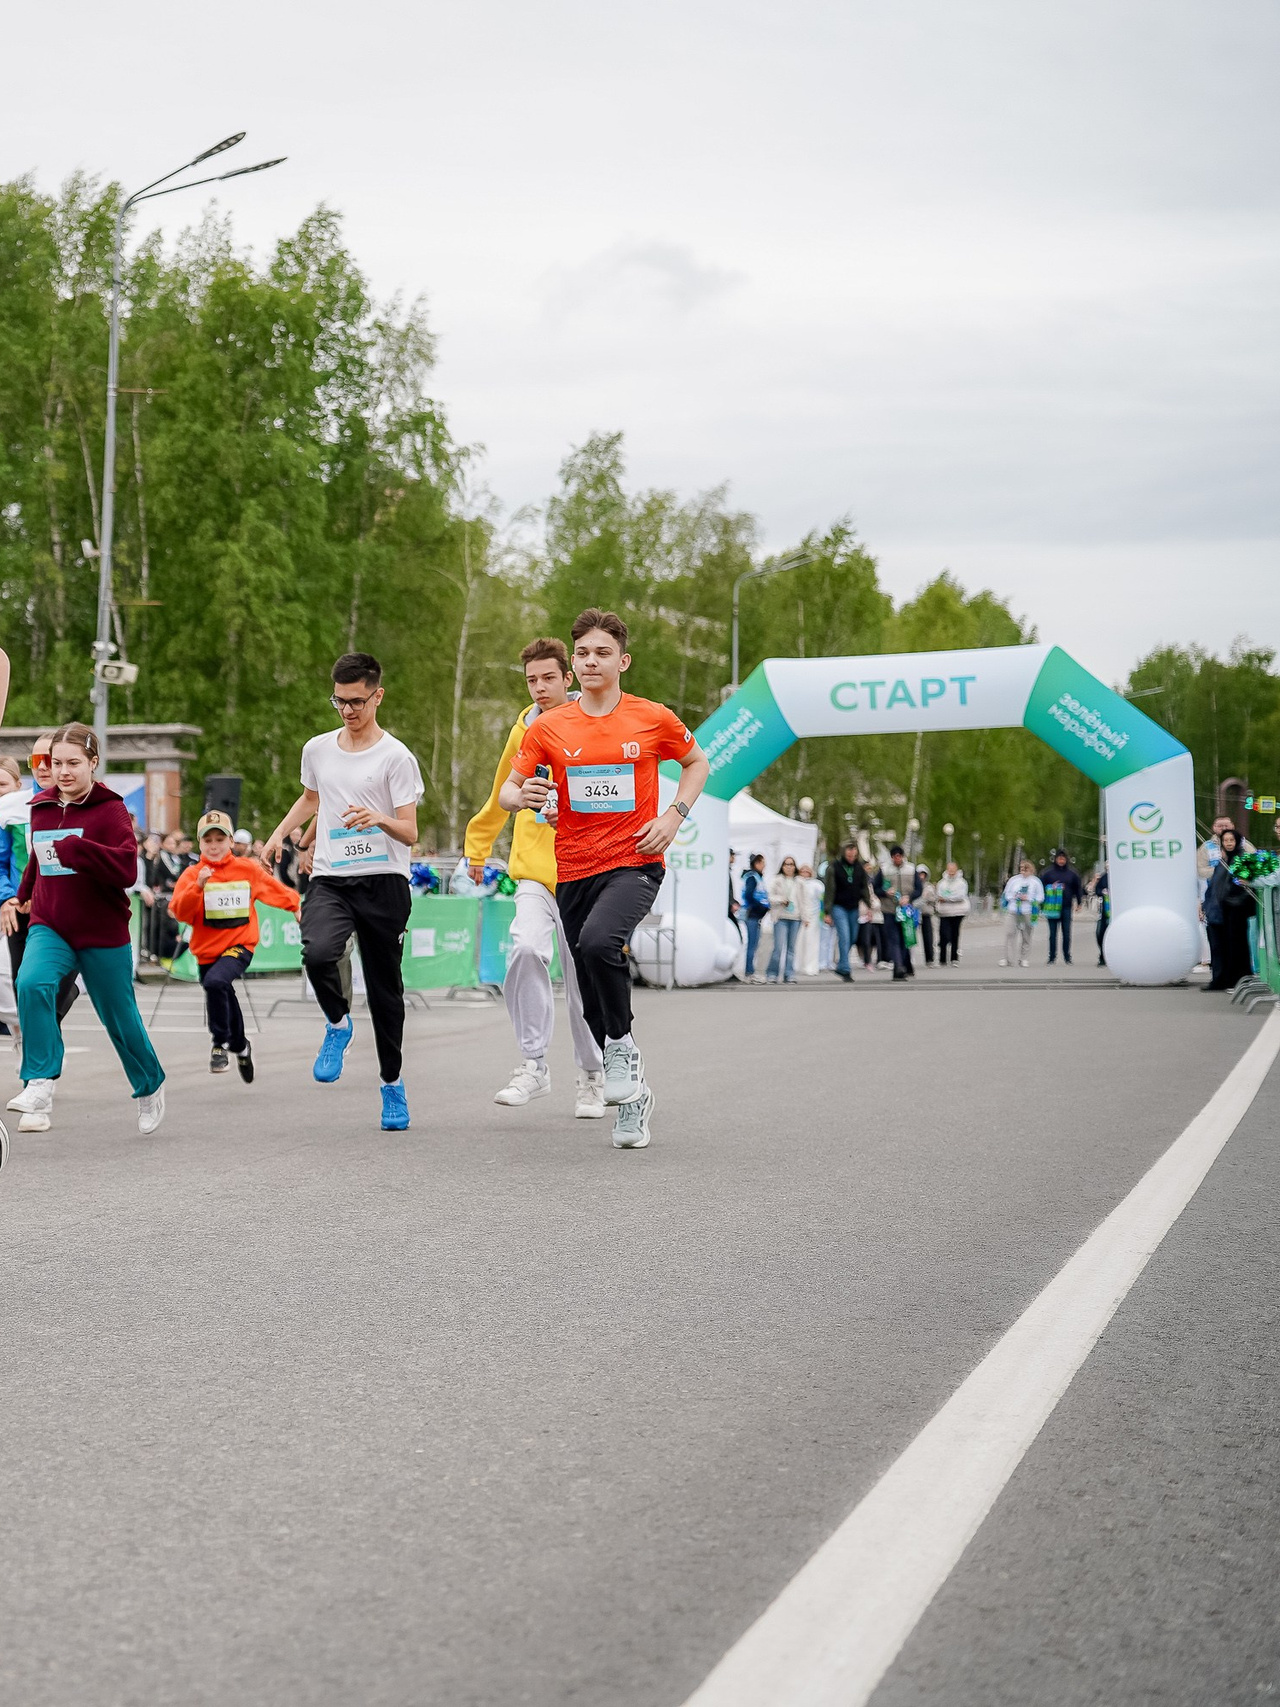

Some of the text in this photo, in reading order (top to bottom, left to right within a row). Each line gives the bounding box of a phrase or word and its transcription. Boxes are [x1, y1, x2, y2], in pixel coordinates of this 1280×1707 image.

[829, 676, 976, 712] СТАРТ
[1059, 692, 1130, 750] зелёный
[704, 706, 753, 760] елёный
[1047, 704, 1116, 761] марафон
[621, 741, 640, 759] 10
[584, 784, 618, 797] 3434
[546, 798, 558, 809] 33
[46, 849, 58, 860] 34
[344, 842, 372, 857] 3356
[1116, 839, 1182, 860] СБЕР
[670, 852, 714, 870] БЕР
[217, 896, 241, 907] 3218
